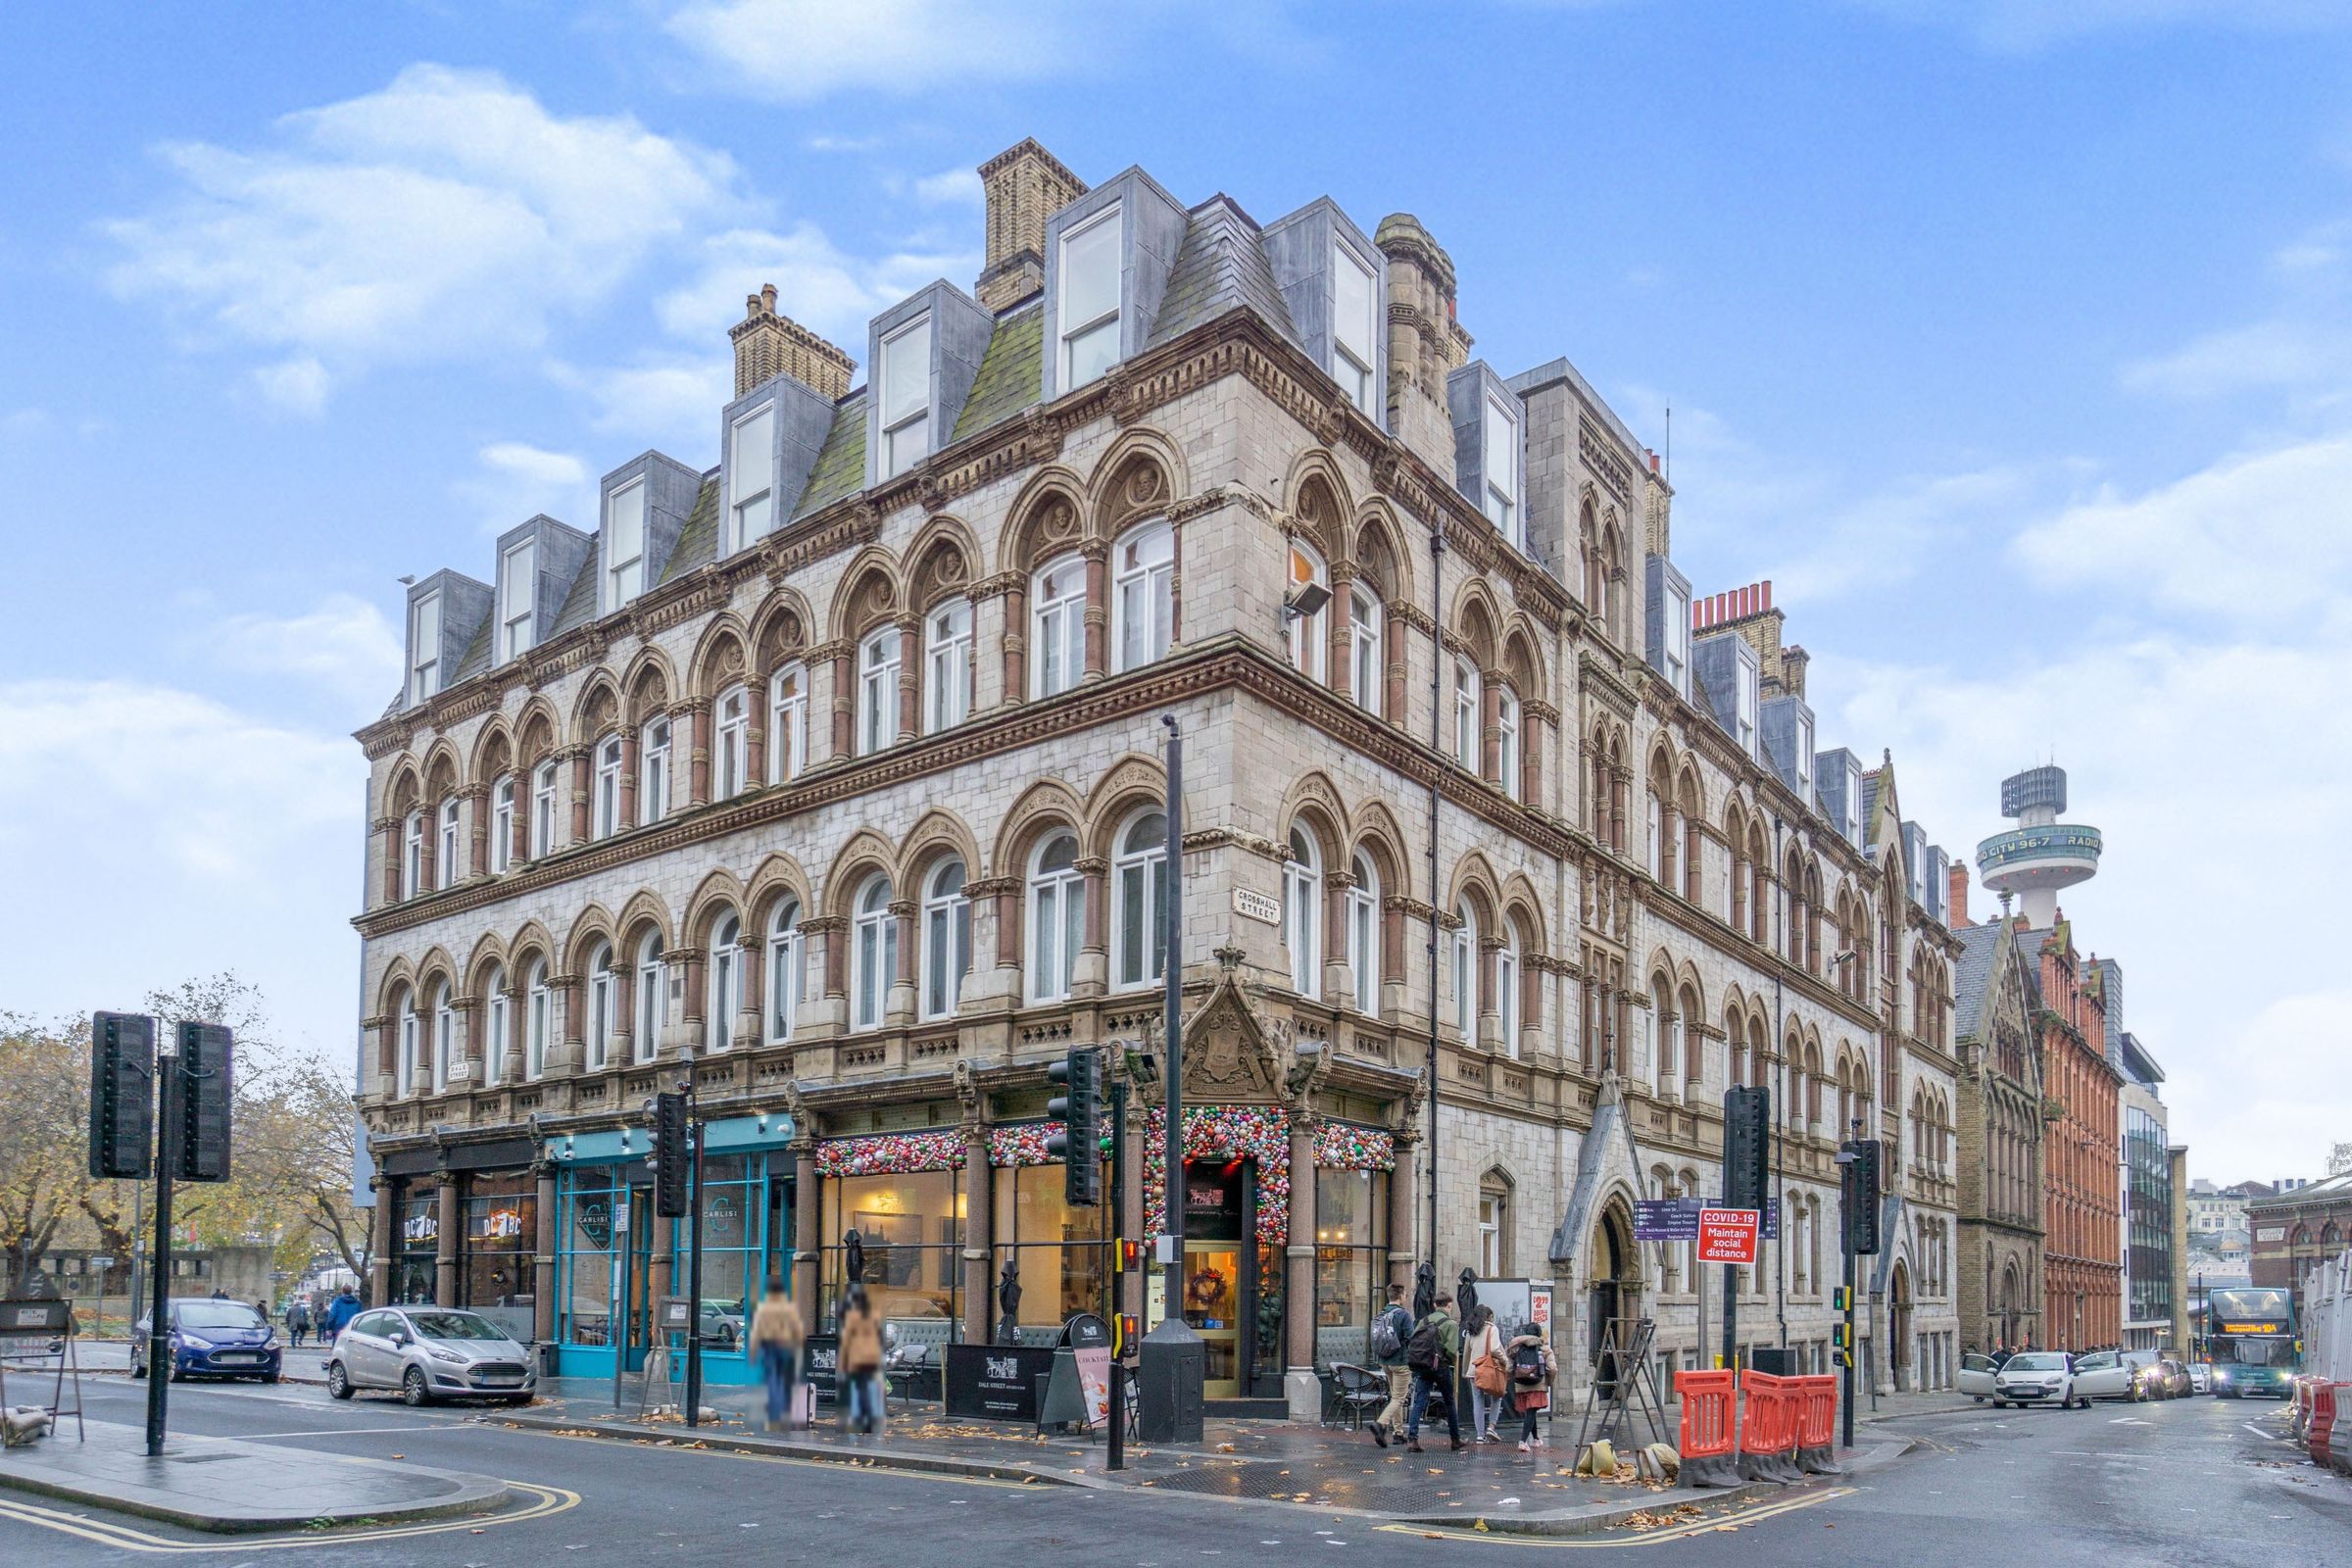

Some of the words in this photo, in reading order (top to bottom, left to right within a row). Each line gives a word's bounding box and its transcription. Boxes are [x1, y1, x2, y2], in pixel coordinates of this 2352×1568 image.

[1989, 842, 2016, 857] CITY
[2068, 836, 2099, 849] RADIO
[1239, 892, 1277, 910] CROSSHALL
[1242, 903, 1274, 919] STREET
[1703, 1213, 1754, 1223] COVID-19
[1708, 1228, 1747, 1238] Maintain
[1713, 1239, 1740, 1248] social
[1706, 1248, 1746, 1258] distance
[2263, 1323, 2278, 1333] 10A
